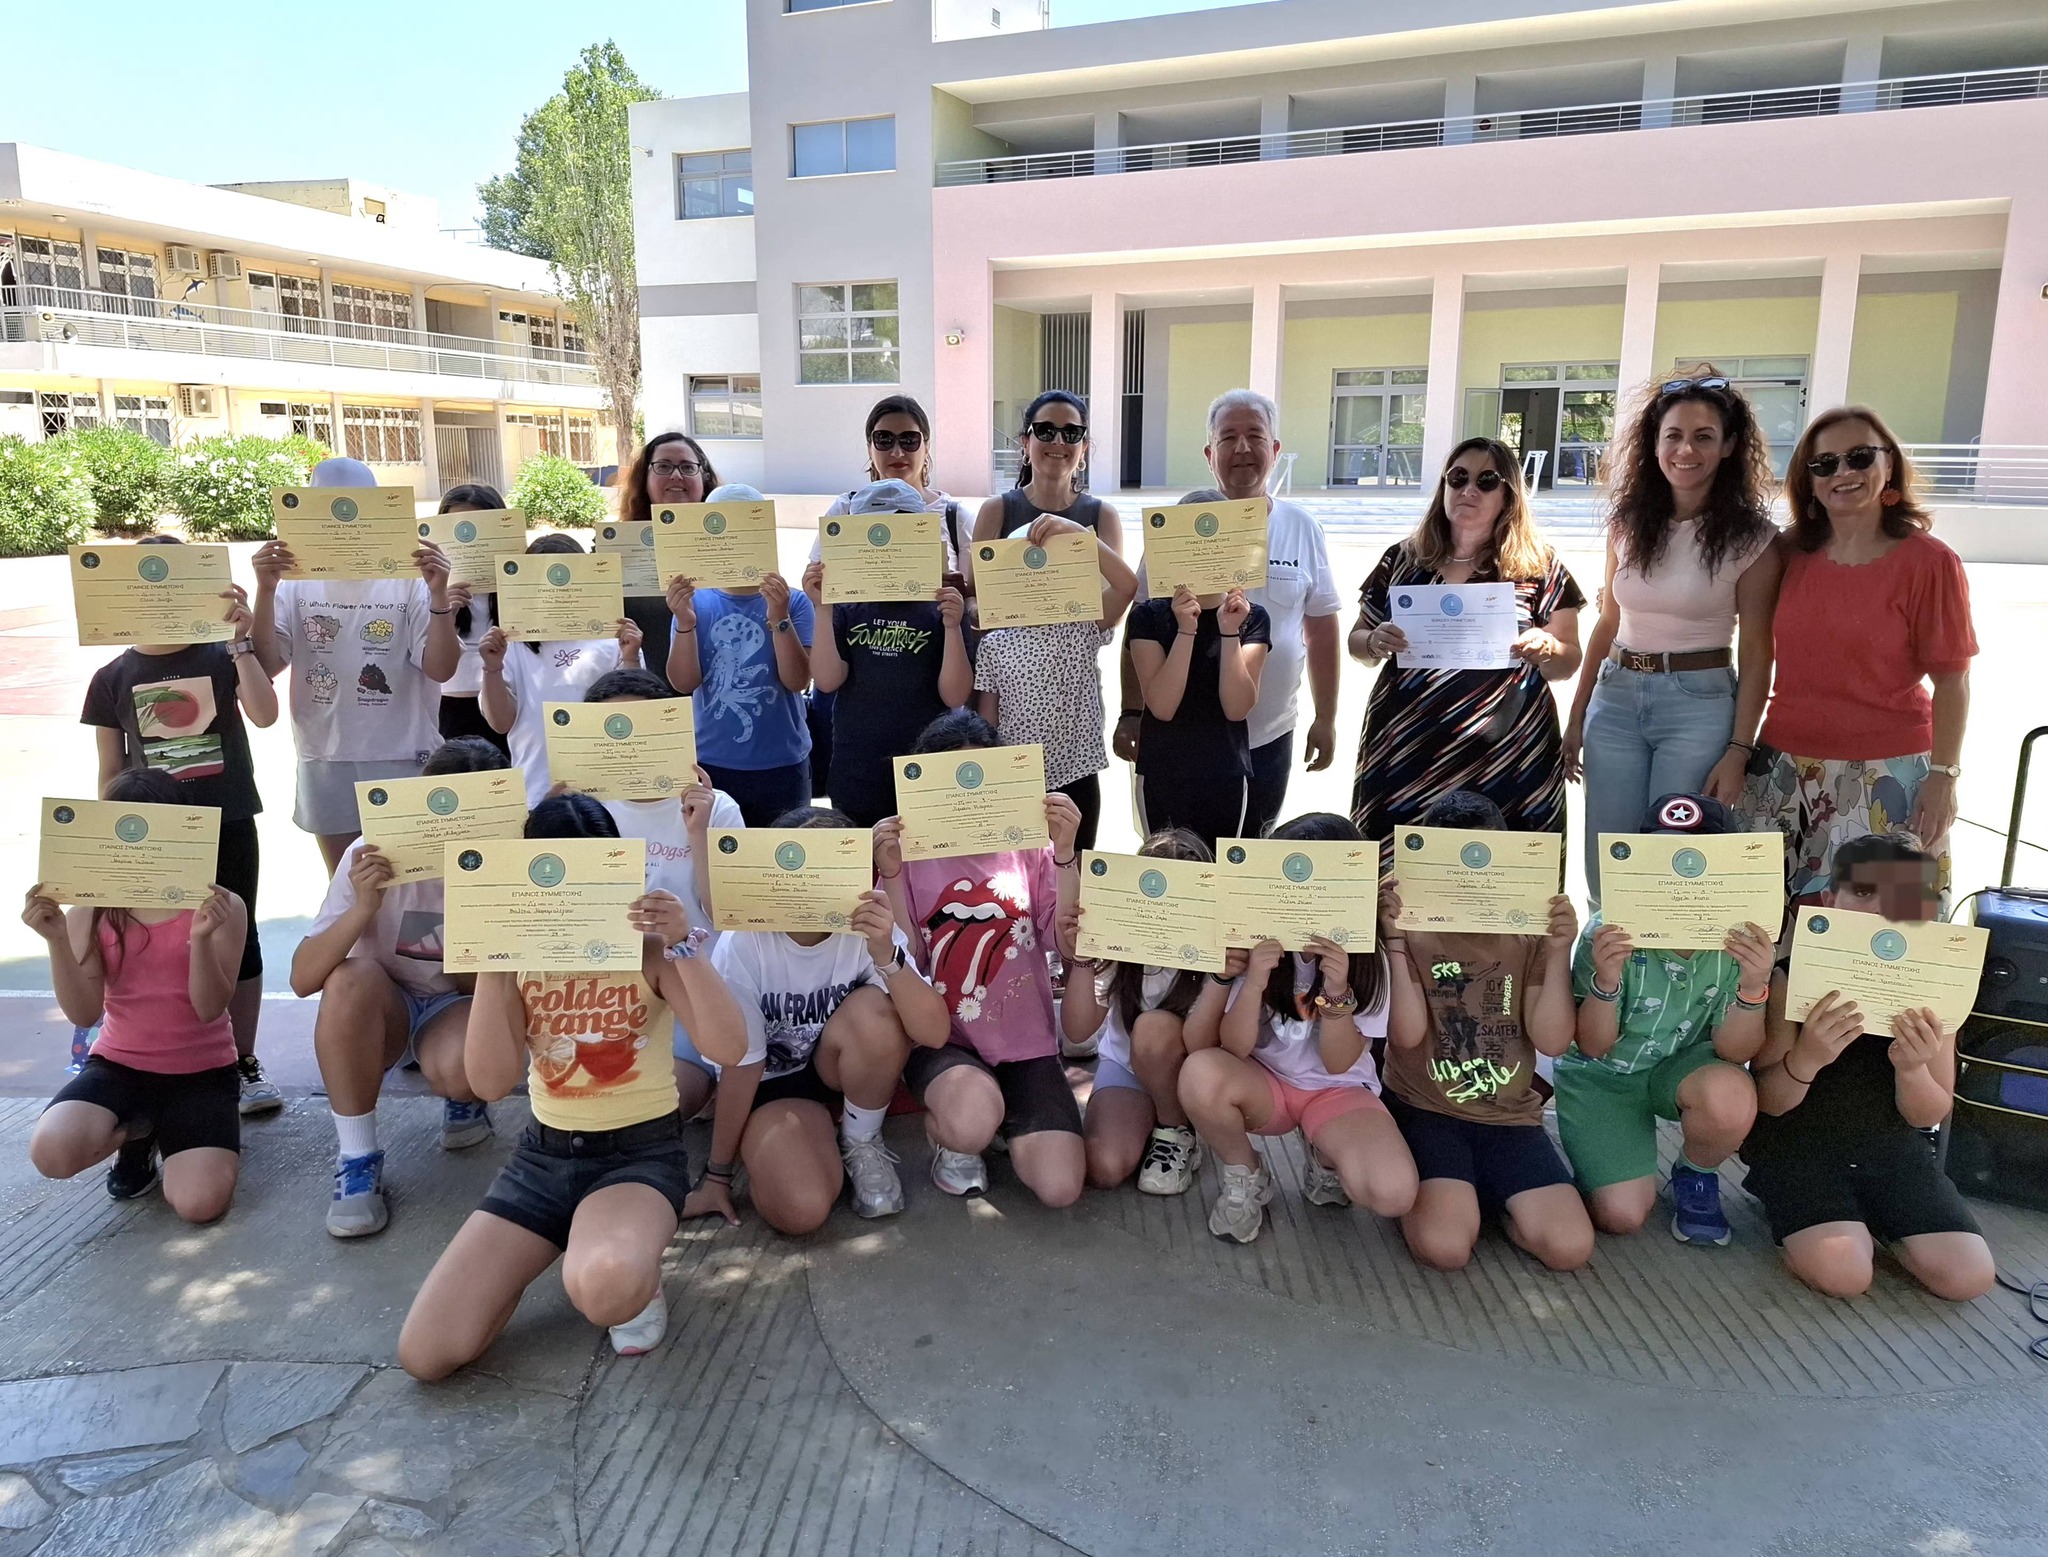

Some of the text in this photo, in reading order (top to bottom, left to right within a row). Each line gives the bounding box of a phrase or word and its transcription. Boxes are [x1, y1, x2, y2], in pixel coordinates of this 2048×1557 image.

[332, 602, 357, 610] Flower
[873, 618, 886, 626] LET
[869, 644, 903, 653] INFLUENCE
[648, 841, 692, 861] Dogs?
[1431, 961, 1462, 979] SK8
[1852, 959, 1921, 974] ΕΠΑΙΝΟΣ ΣΥΜΜΕΤΟΧΗΣ
[522, 978, 640, 1012] Golden
[526, 1004, 648, 1041] range
[1481, 1024, 1518, 1037] SKATER
